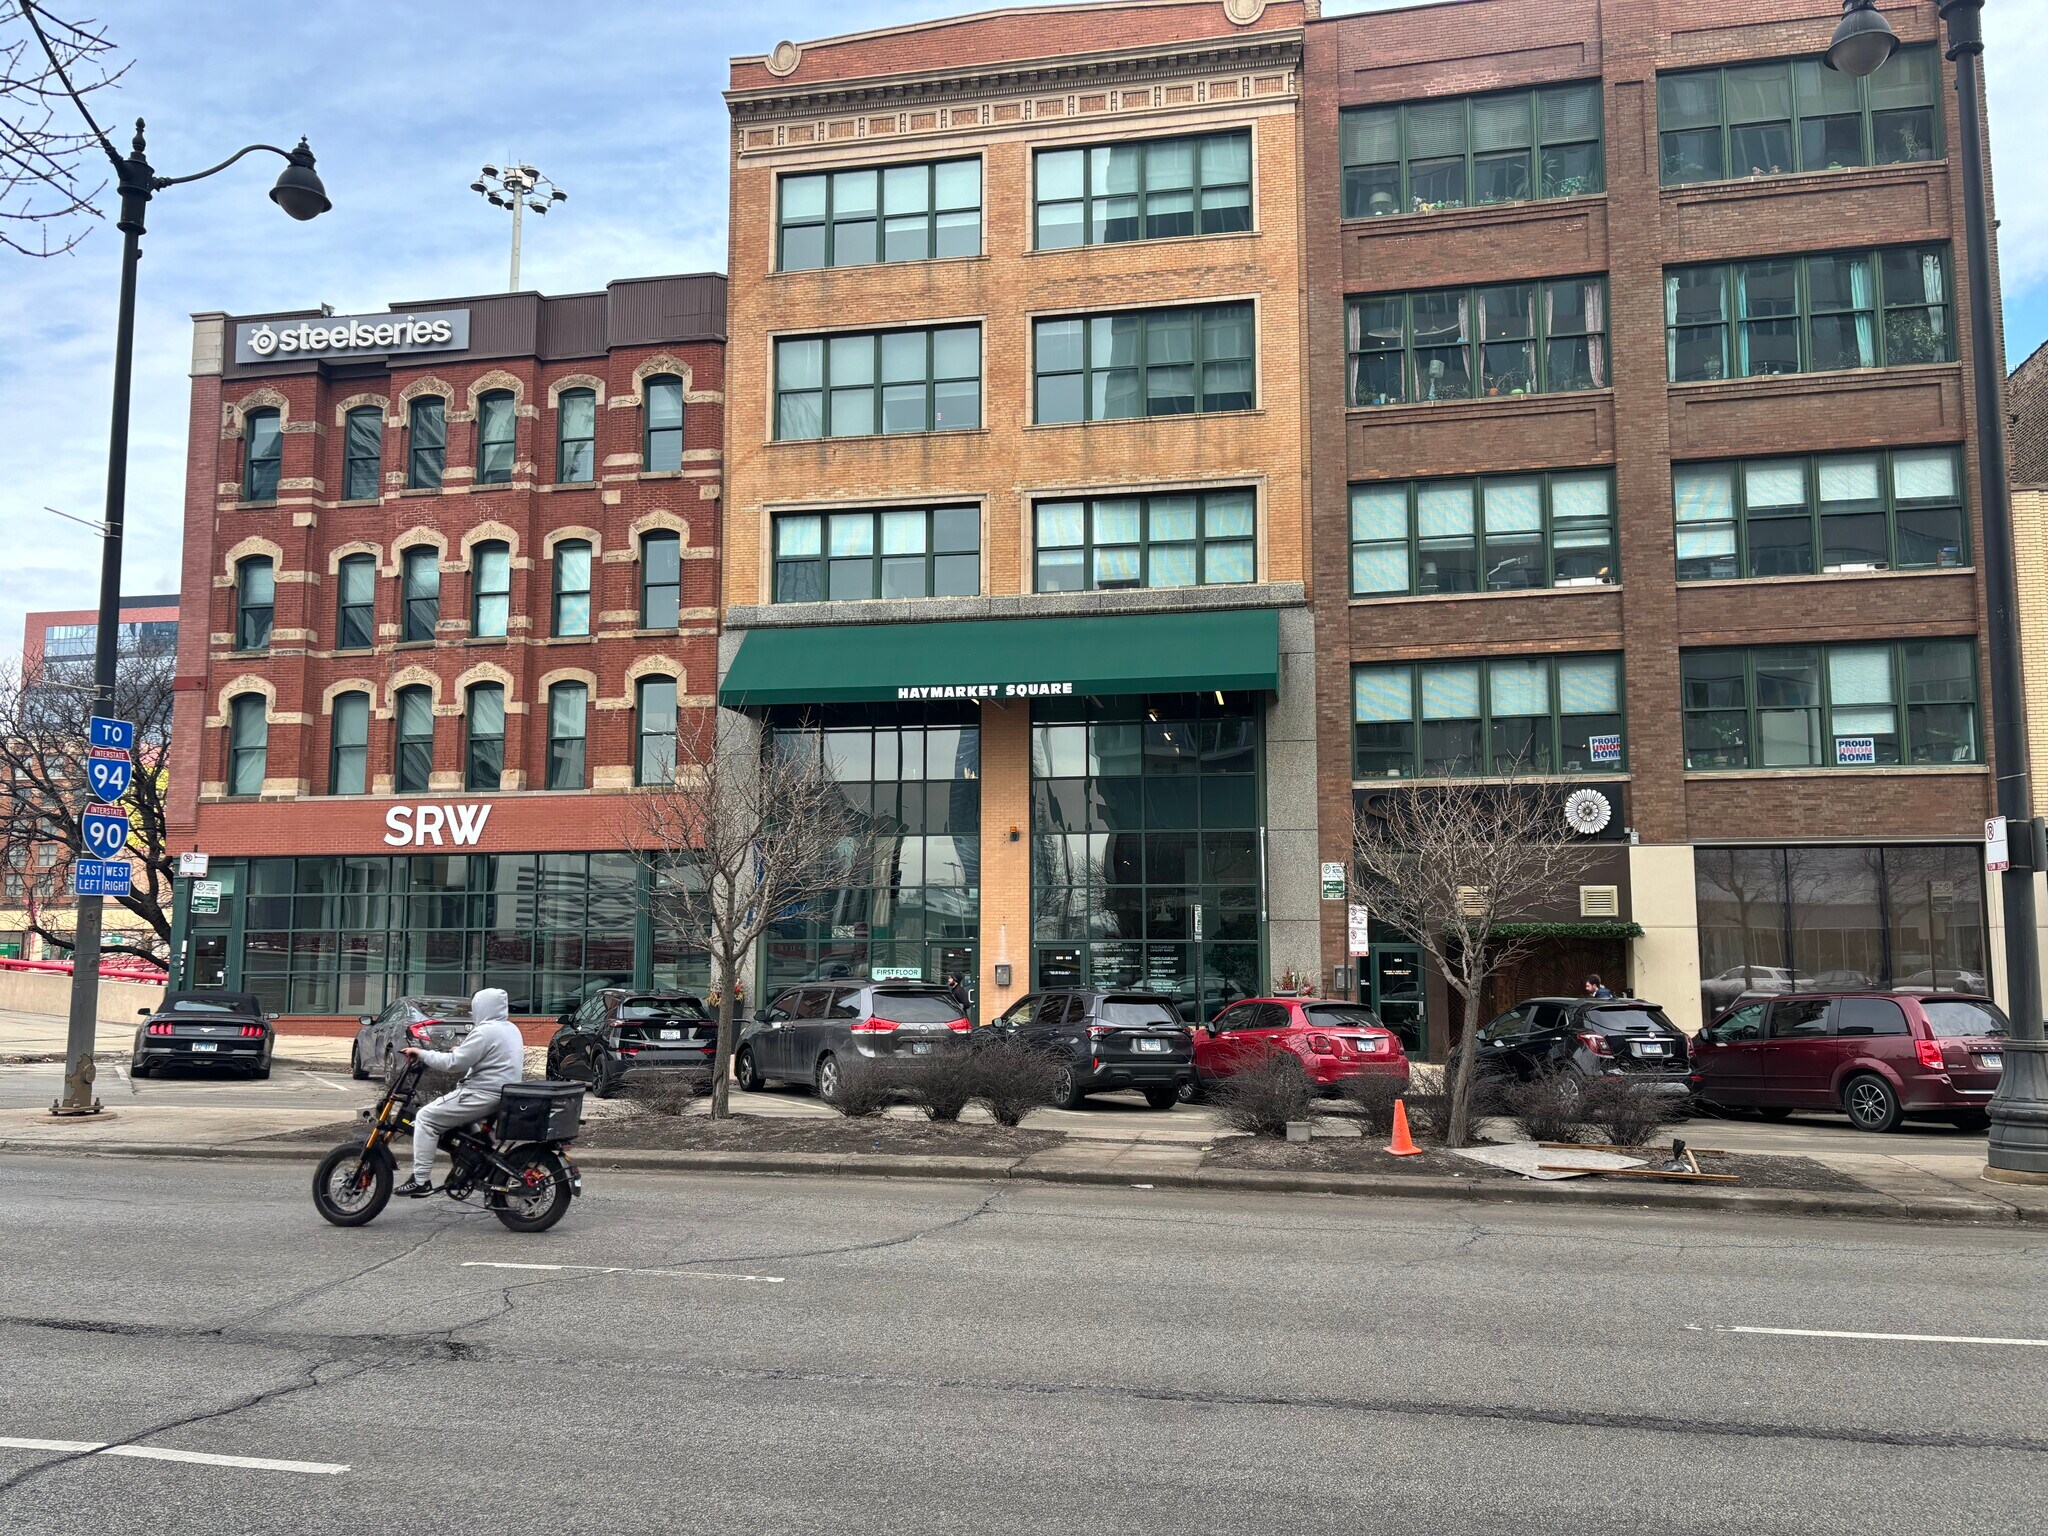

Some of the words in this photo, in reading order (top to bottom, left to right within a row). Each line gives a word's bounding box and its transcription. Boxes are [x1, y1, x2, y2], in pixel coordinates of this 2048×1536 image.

[279, 315, 452, 351] steelseries
[898, 685, 998, 699] HAYMARKET
[1005, 682, 1073, 698] SQUARE
[102, 724, 123, 742] TO
[94, 749, 126, 760] INTERSTATE
[93, 763, 124, 791] 94
[90, 805, 123, 817] INTERSTATE
[383, 804, 493, 847] SRW
[89, 821, 122, 849] 90
[78, 864, 102, 877] EAST
[105, 865, 129, 877] WEST
[78, 879, 101, 890] LEFT
[105, 880, 129, 892] RIGHT
